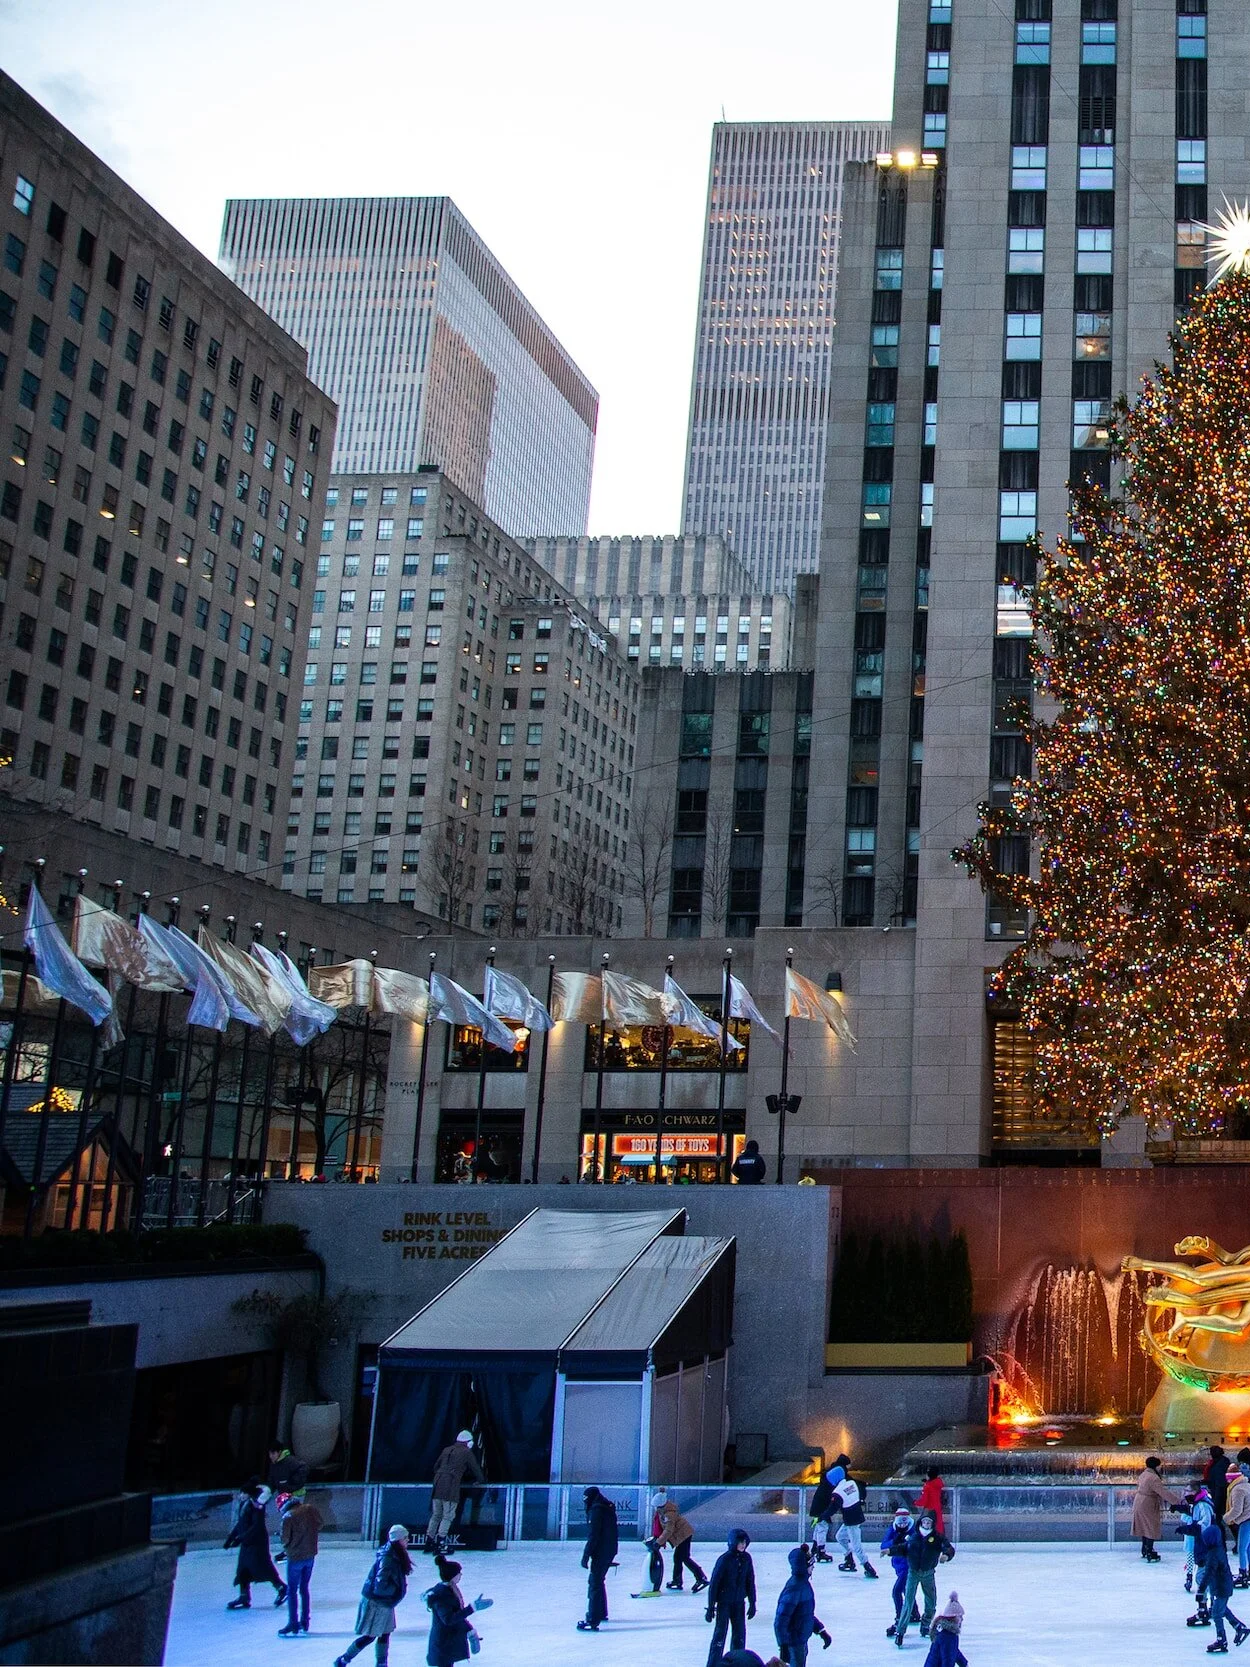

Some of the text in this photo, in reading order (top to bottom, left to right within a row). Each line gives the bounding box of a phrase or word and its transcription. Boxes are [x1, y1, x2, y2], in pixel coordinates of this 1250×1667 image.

[661, 1115, 716, 1125] CHWARZ
[630, 1138, 647, 1152] 160
[675, 1138, 686, 1152] OF
[687, 1138, 710, 1152] TOYS
[403, 1212, 491, 1225] RINK LEVEL
[382, 1229, 435, 1243] SHOPS
[438, 1229, 449, 1242] &
[402, 1246, 489, 1259] FIVE ACRES
[614, 1500, 632, 1510] NK
[445, 1533, 460, 1546] NK
